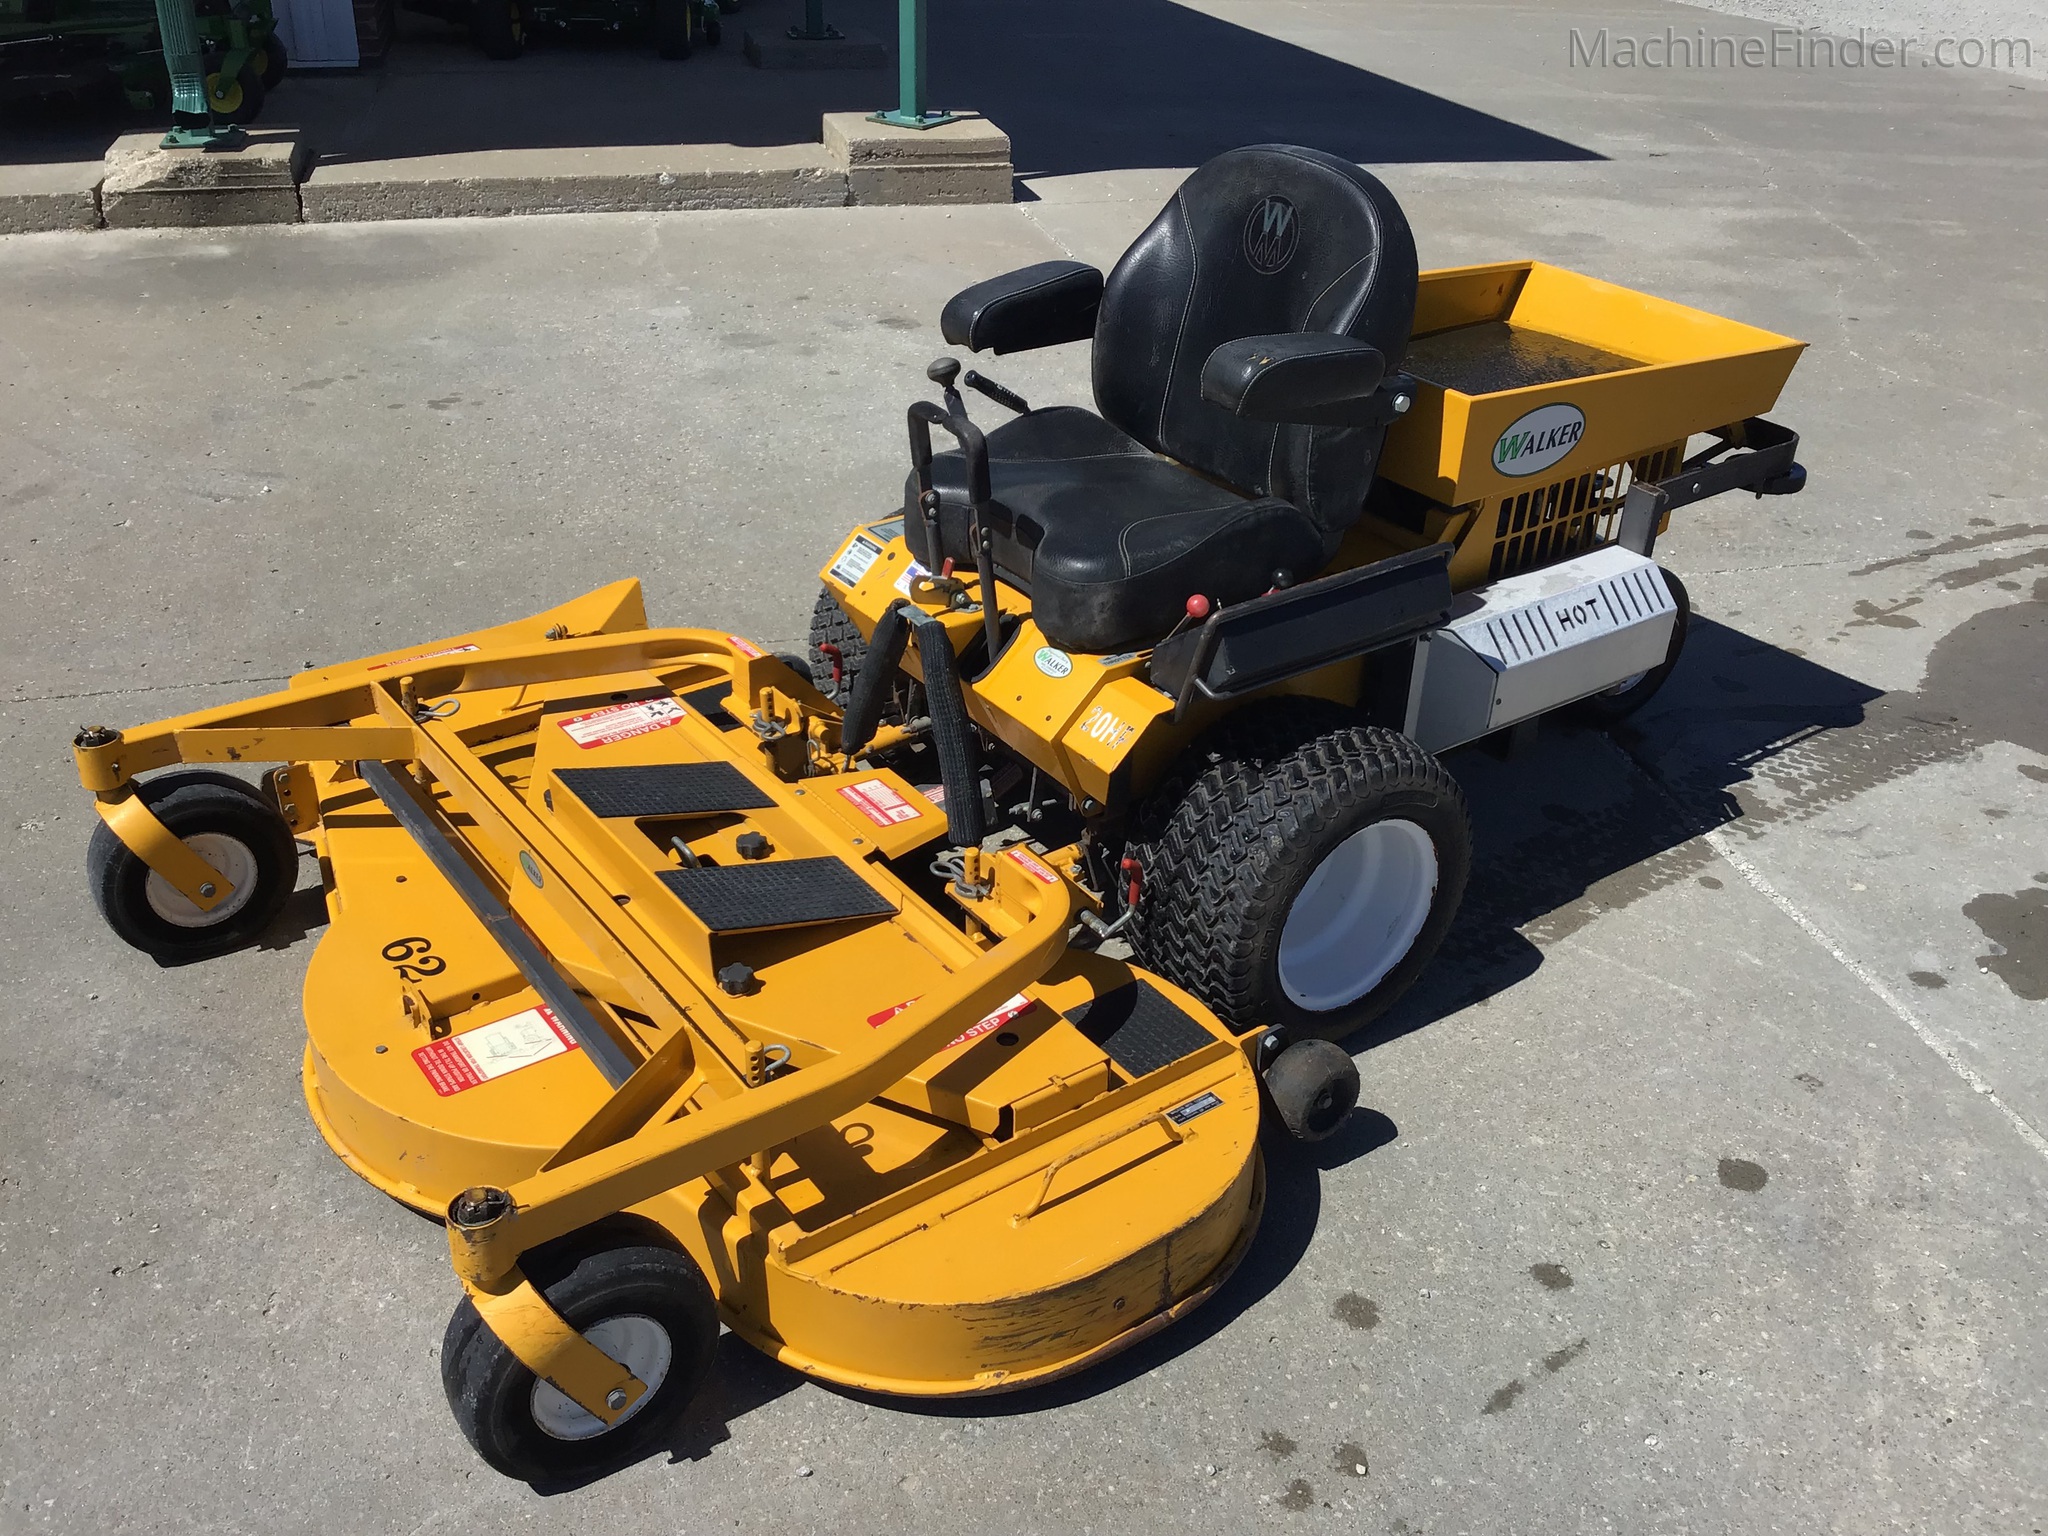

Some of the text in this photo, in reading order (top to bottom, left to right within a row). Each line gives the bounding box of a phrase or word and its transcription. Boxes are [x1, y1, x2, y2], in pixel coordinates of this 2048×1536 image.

[1498, 421, 1582, 464] WALKER
[1555, 598, 1600, 632] HOT
[1036, 650, 1069, 675] WALKER
[590, 706, 620, 719] STEP
[601, 720, 662, 744] DANGER
[381, 936, 447, 984] 62
[965, 1017, 1001, 1037] STEP
